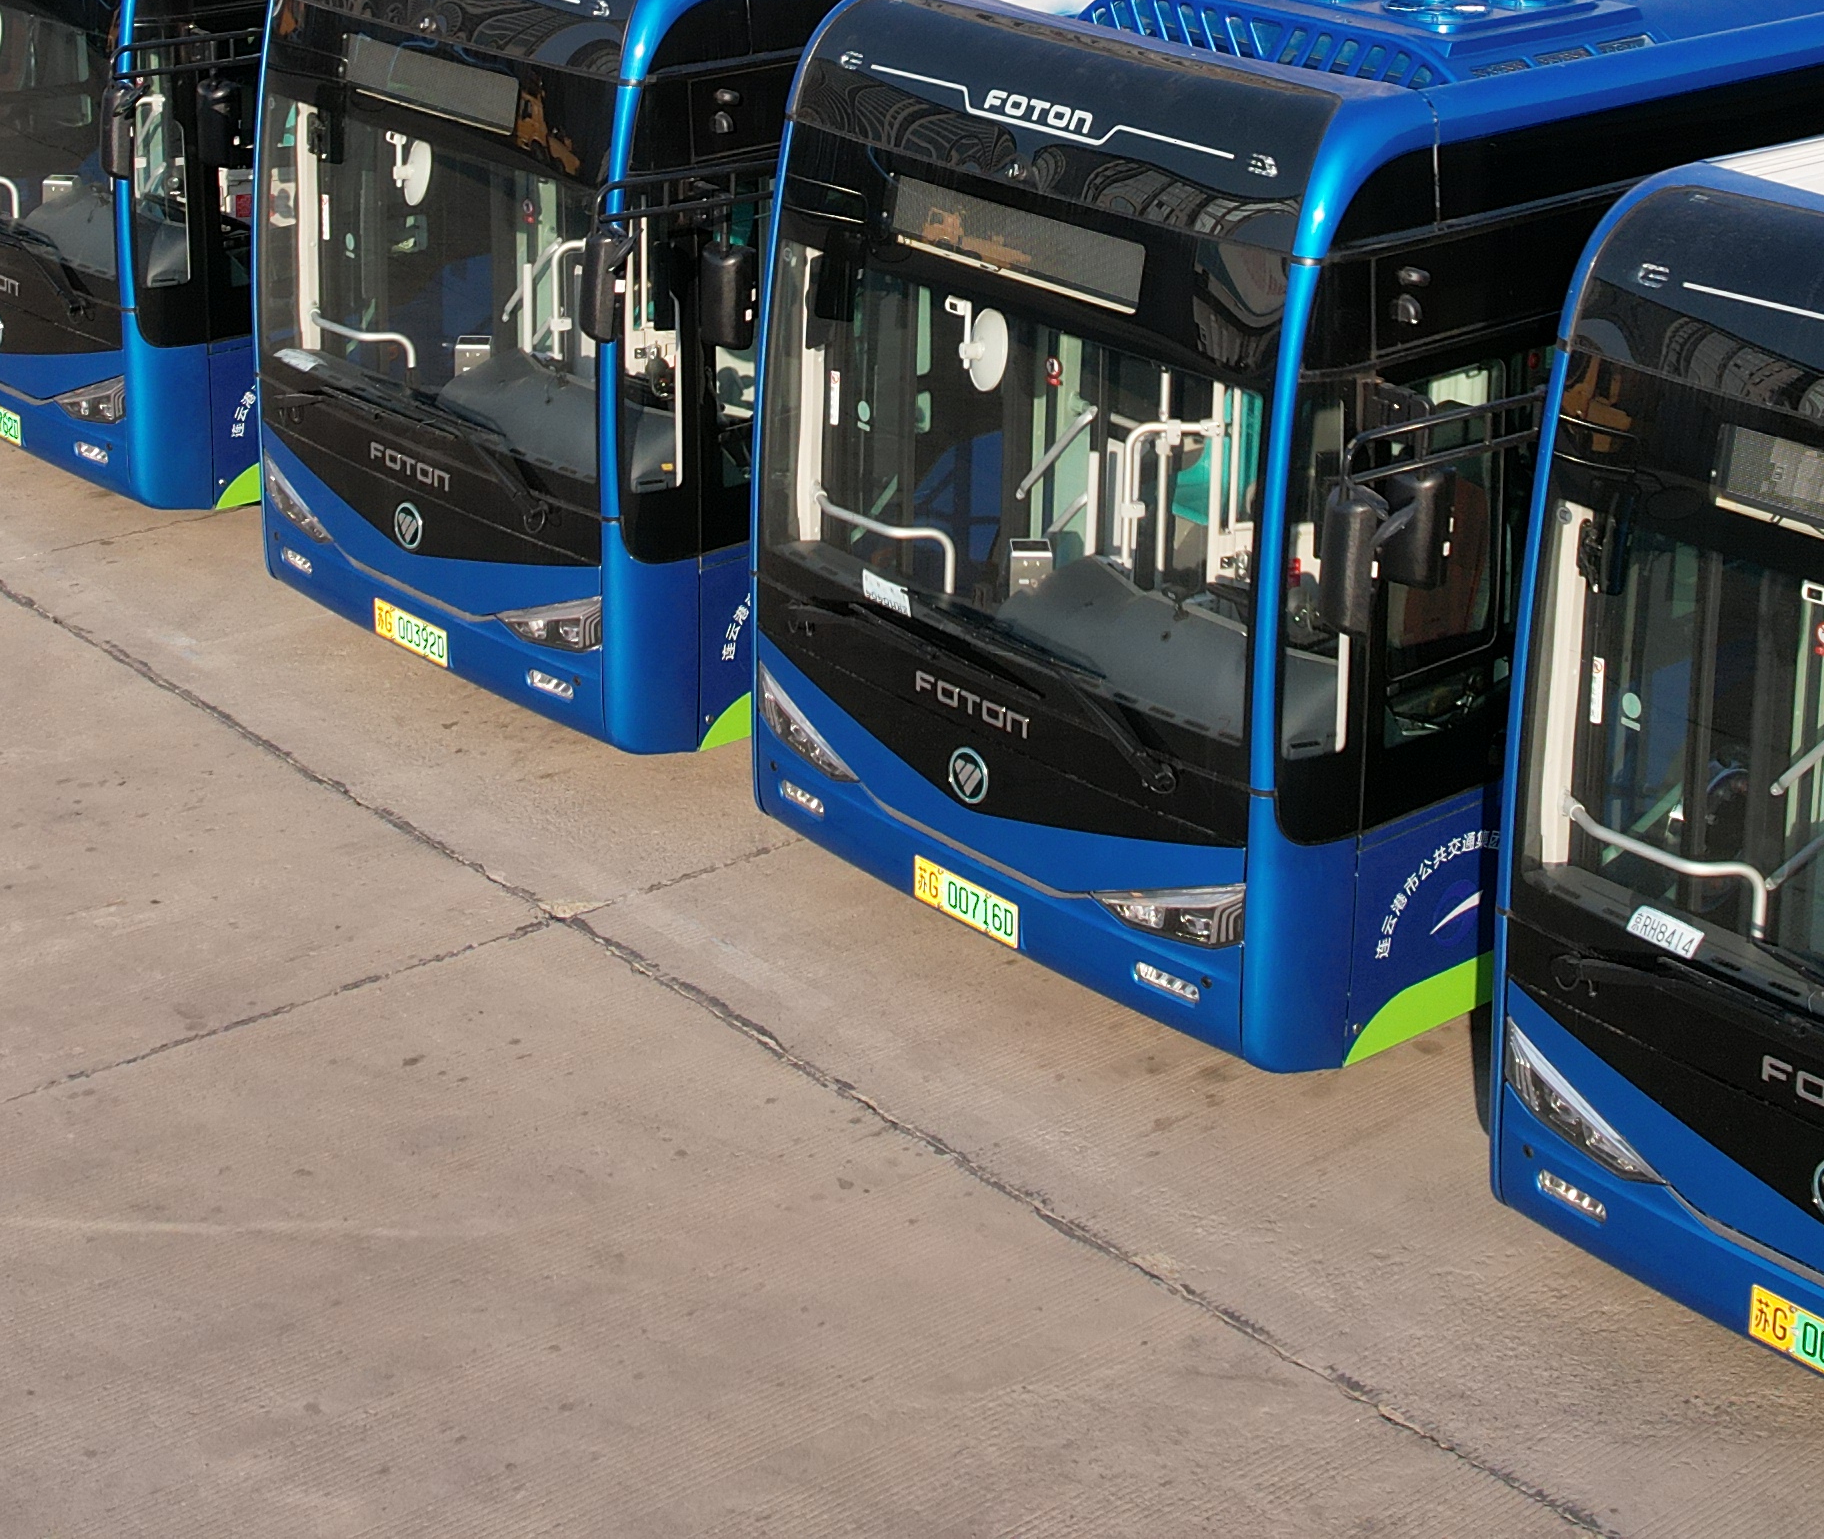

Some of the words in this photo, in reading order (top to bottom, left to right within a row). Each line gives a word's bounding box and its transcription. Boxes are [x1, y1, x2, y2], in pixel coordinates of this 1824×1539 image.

[984, 89, 1093, 134] FOTON
[231, 385, 256, 437] 连云港
[370, 442, 451, 492] FOTON
[398, 616, 444, 658] 00392D
[916, 669, 1030, 740] FOTON
[918, 865, 938, 898] 苏G
[948, 881, 1013, 937] 00716D
[1755, 1298, 1788, 1341] 苏G
